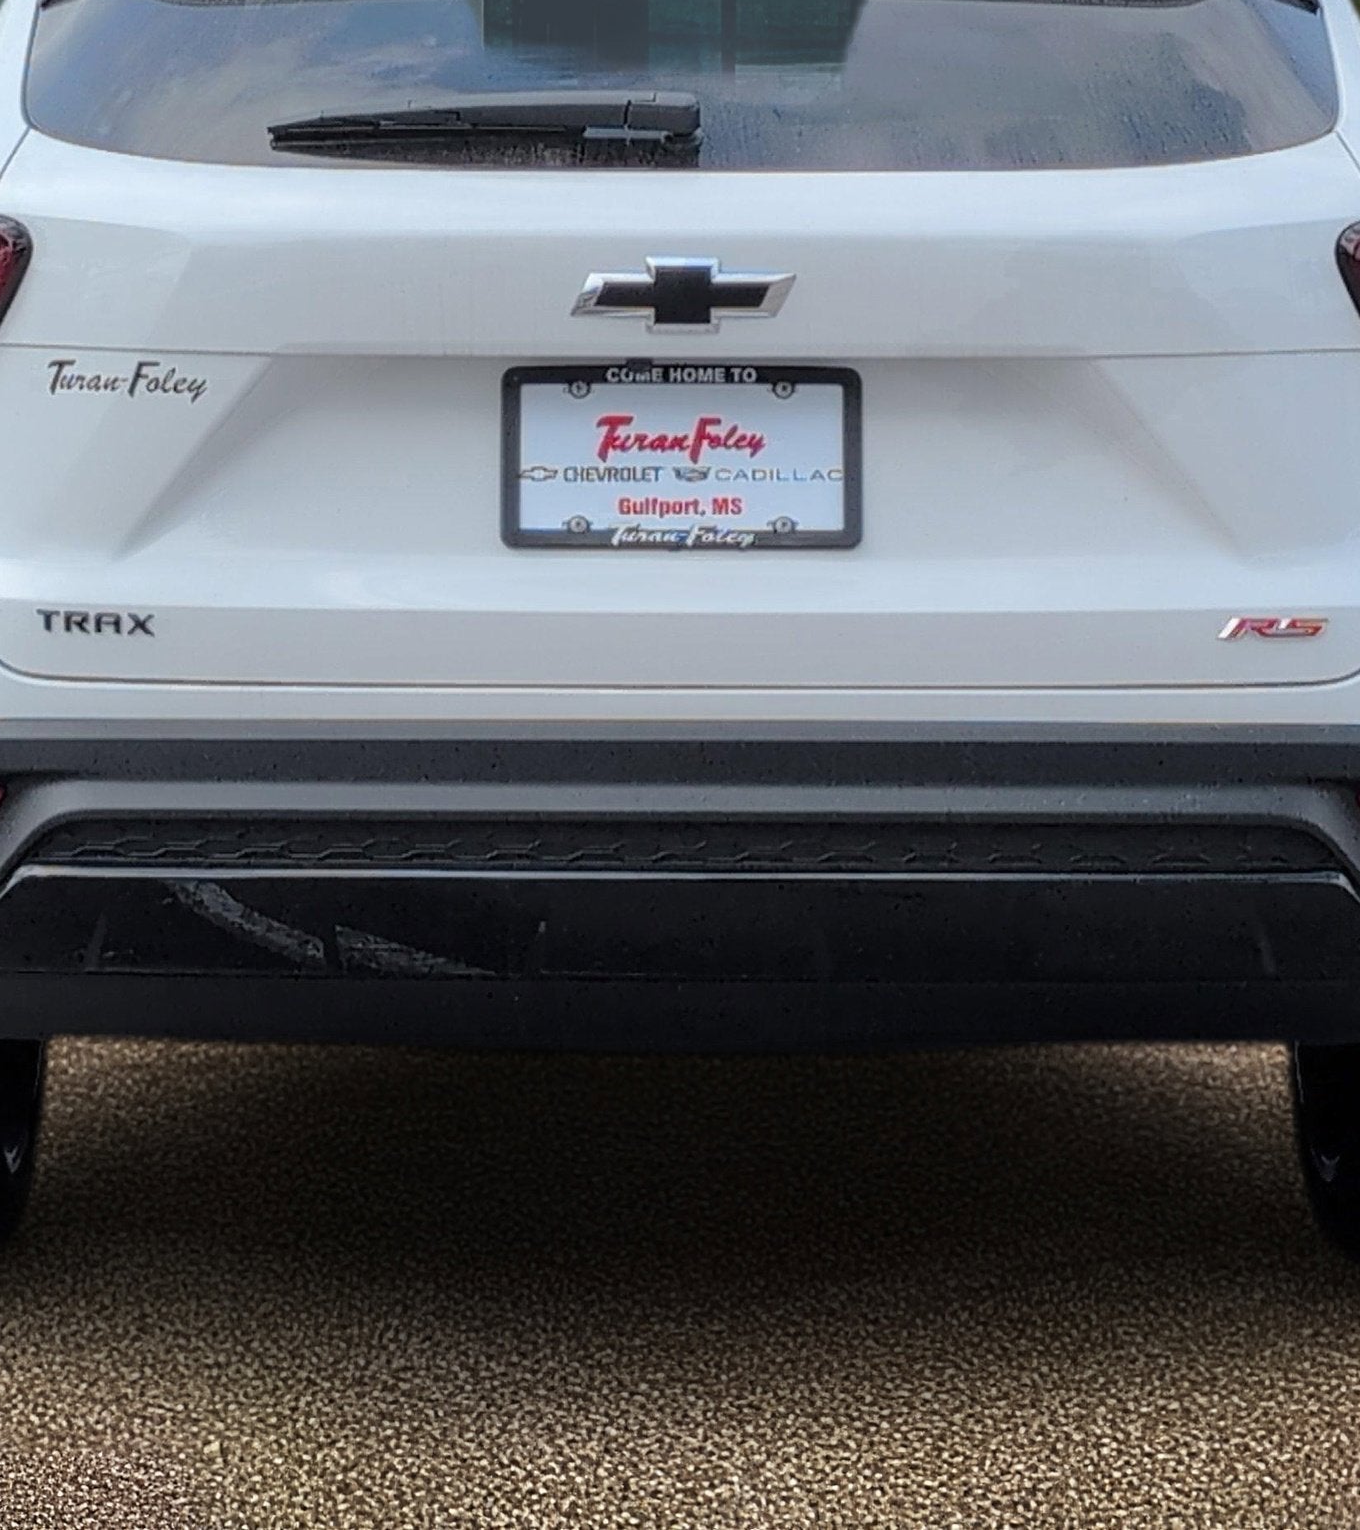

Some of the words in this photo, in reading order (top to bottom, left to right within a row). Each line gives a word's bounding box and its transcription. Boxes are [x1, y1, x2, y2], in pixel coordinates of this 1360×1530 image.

[669, 367, 727, 383] HOME
[730, 367, 758, 383] TO
[563, 465, 662, 483] CHEVROLET
[714, 467, 844, 482] CADILLAC
[618, 497, 706, 518] Gulfport,
[712, 497, 743, 516] MS
[36, 608, 156, 638] TRAX
[1217, 617, 1328, 640] RS
